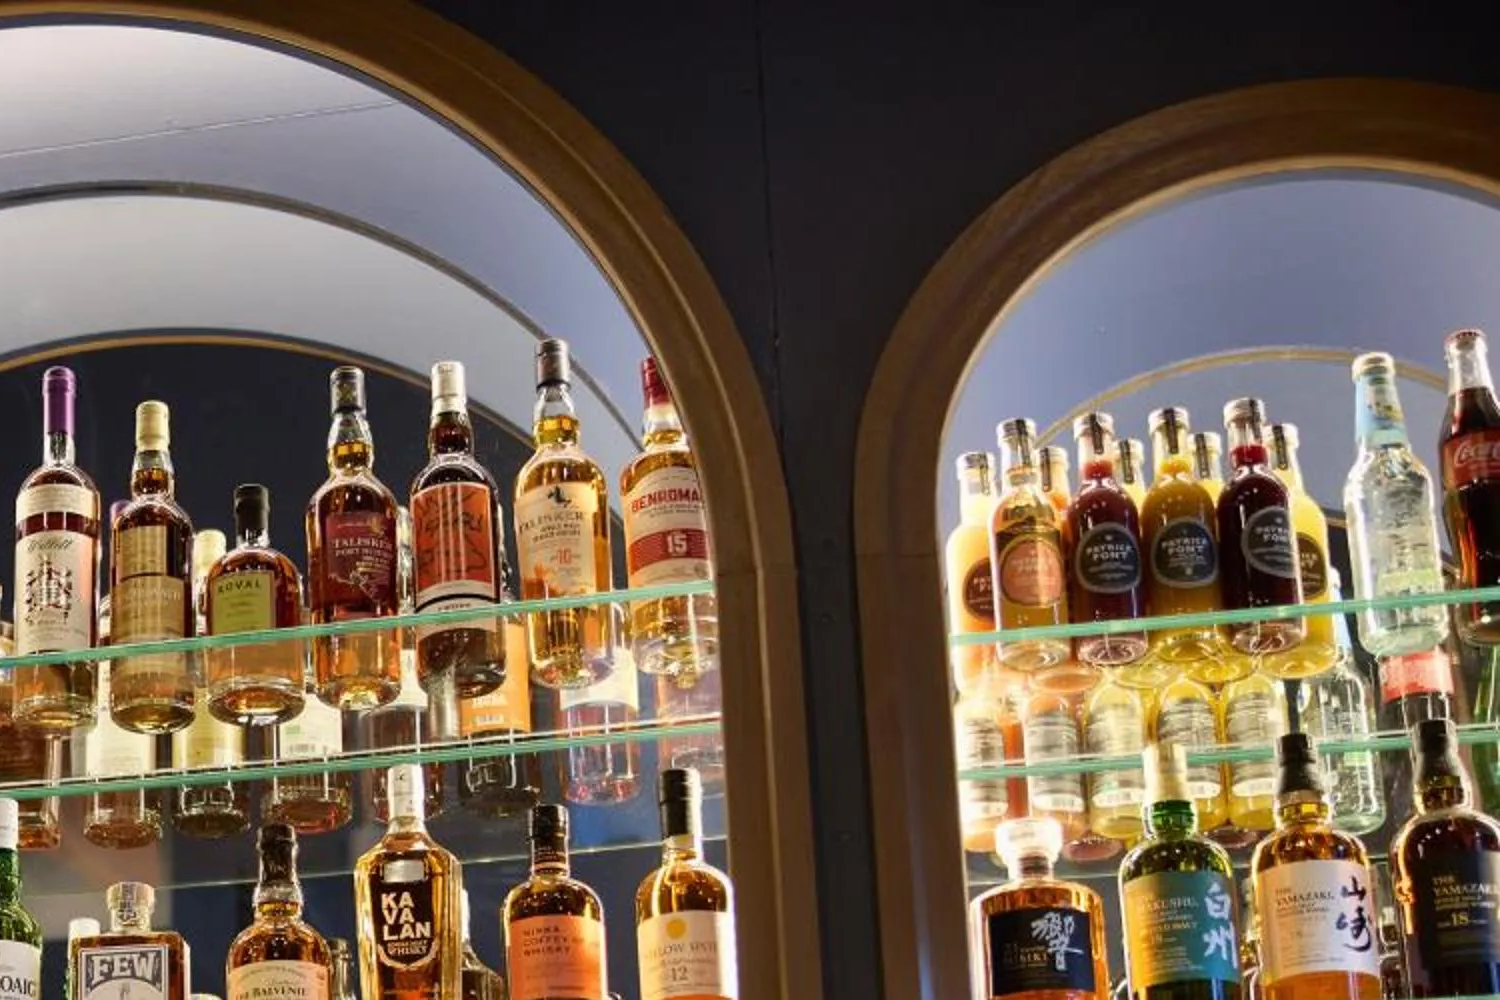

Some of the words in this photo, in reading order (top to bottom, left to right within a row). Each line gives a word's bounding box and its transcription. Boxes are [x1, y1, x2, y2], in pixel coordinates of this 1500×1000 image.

[331, 538, 393, 551] TALISKER
[667, 530, 688, 556] 15
[381, 891, 414, 909] KA
[382, 907, 414, 925] VA
[1203, 881, 1239, 970] 白州
[1336, 875, 1373, 954] 山崎
[383, 921, 431, 941] LAN
[90, 952, 157, 982] FEW
